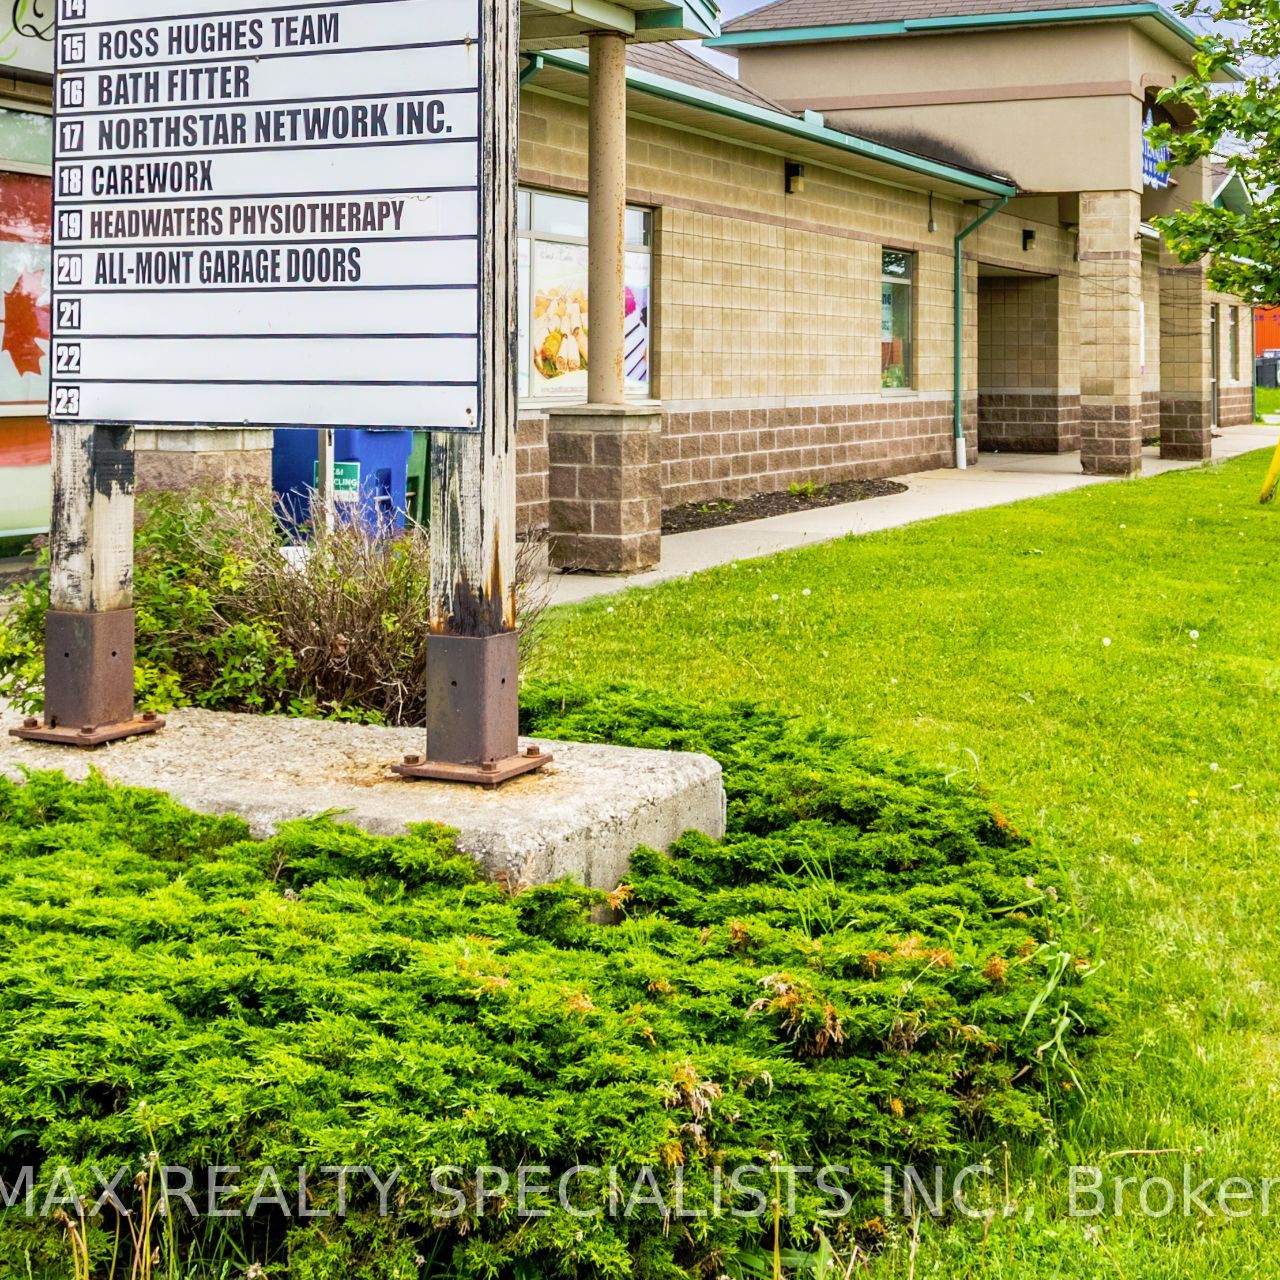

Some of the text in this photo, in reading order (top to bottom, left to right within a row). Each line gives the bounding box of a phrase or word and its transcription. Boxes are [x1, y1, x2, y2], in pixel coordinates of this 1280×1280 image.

[62, 13, 339, 60] 15 ROSS HUGHES TEAM
[61, 66, 249, 106] 16 BATH FITTER
[60, 100, 452, 150] 17 NORTHSTAR NETWORK INC.
[60, 160, 213, 196] 18 CAREWORX
[60, 201, 404, 238] 19 HEADWATERS PHYSIOTHERAPY
[59, 248, 361, 284] 20 ALL-MONT GARAGE DOORS
[58, 302, 79, 326] 21
[57, 346, 79, 370] 22
[56, 389, 79, 414] 23
